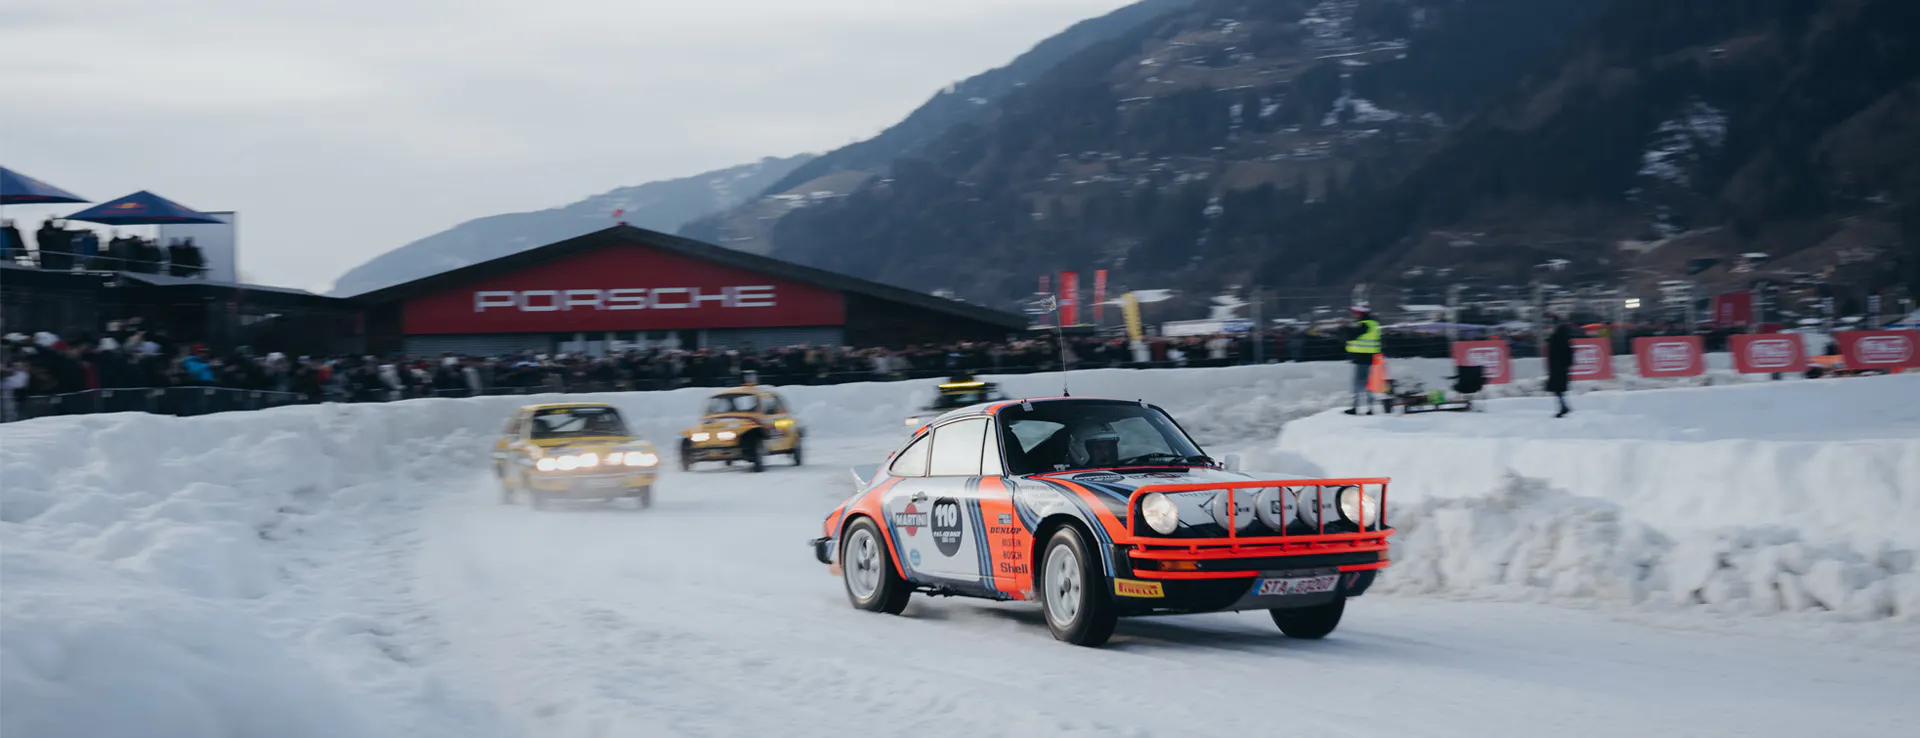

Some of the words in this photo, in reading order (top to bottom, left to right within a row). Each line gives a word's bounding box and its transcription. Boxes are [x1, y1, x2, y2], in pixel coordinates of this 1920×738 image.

[474, 285, 776, 312] PORSCHE
[895, 513, 928, 526] MARTINI
[935, 503, 958, 528] 110
[990, 526, 1022, 535] DUNLOP
[1003, 550, 1023, 560] BOSCH
[1000, 561, 1029, 574] Shell
[1118, 582, 1159, 596] PIRELLI
[1260, 580, 1288, 594] STA
